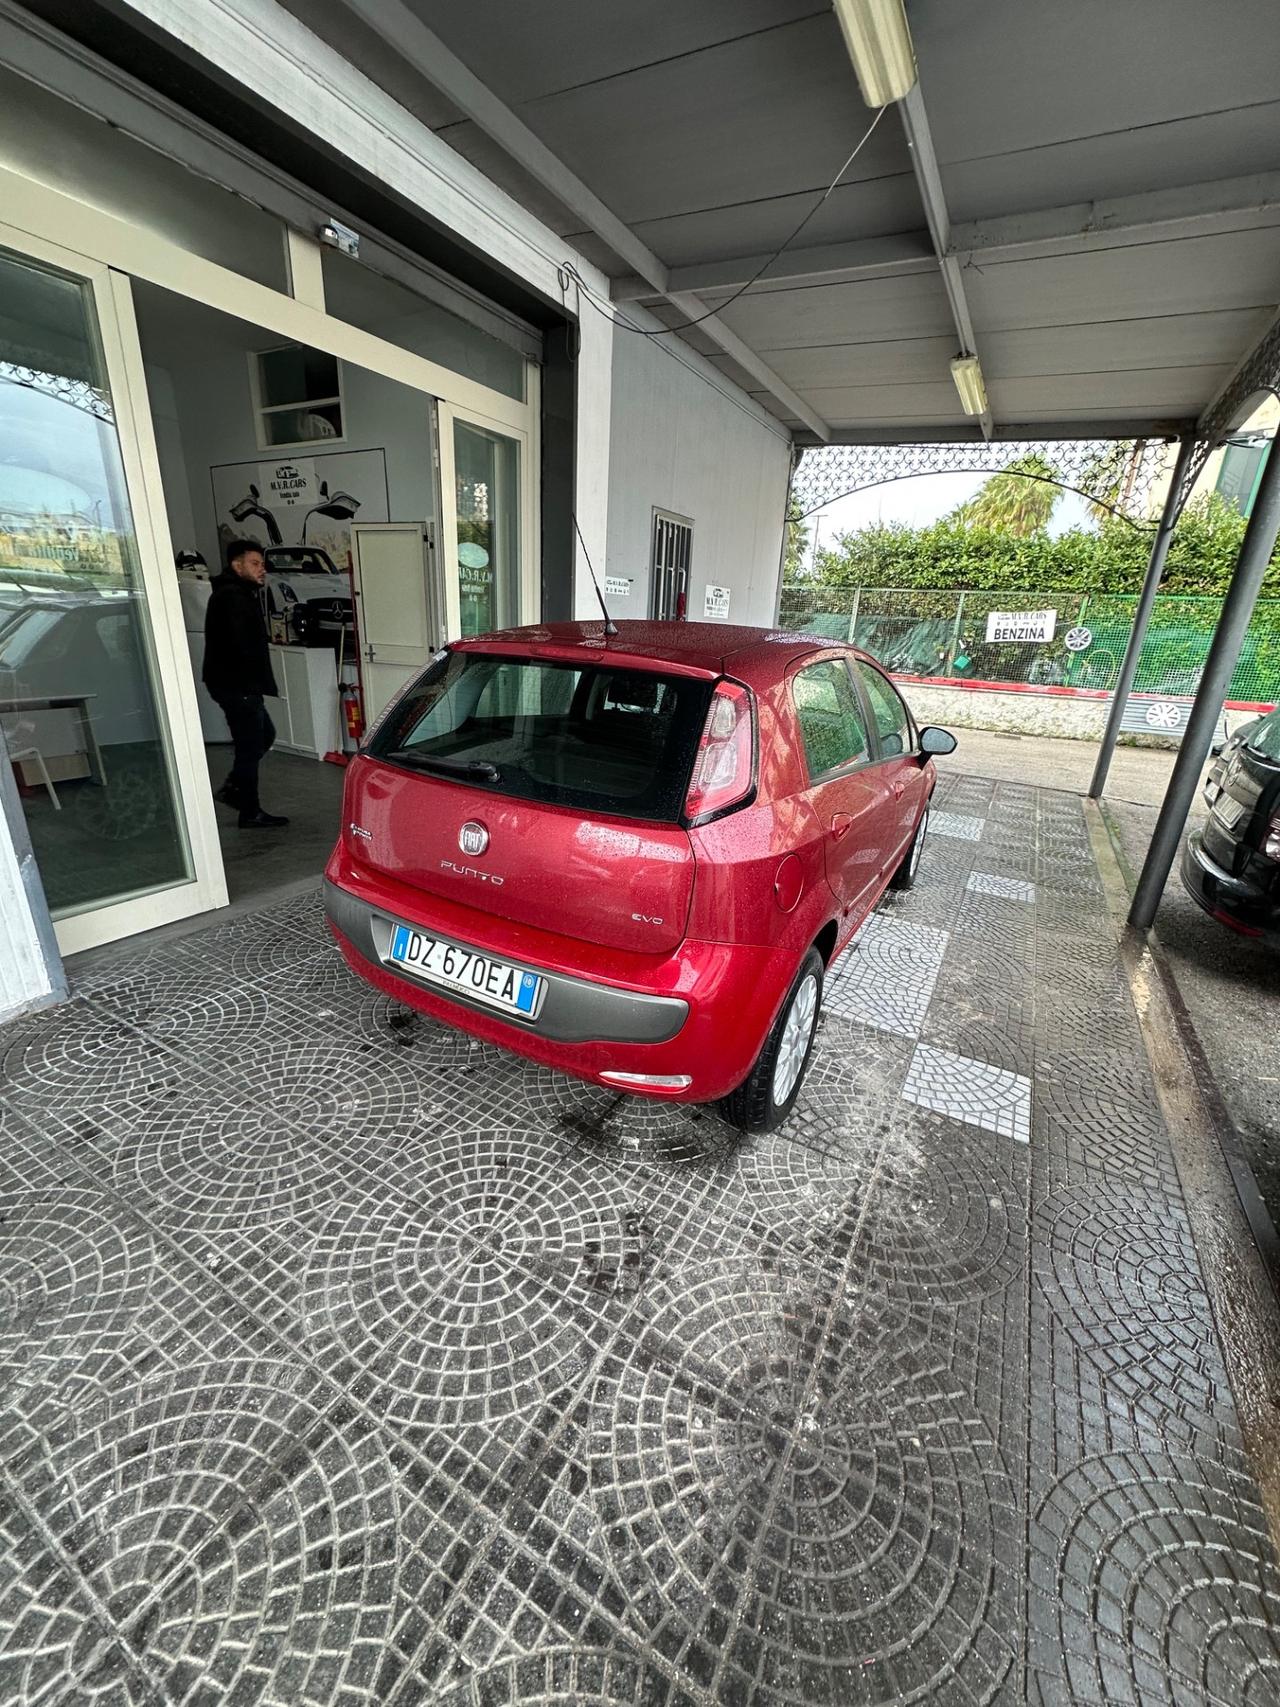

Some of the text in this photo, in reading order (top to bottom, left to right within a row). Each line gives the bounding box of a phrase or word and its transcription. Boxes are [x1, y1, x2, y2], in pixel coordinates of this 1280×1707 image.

[994, 627, 1045, 640] BENZINA
[464, 831, 482, 847] FIAT
[440, 859, 504, 886] PUNTO
[631, 912, 664, 925] EVO
